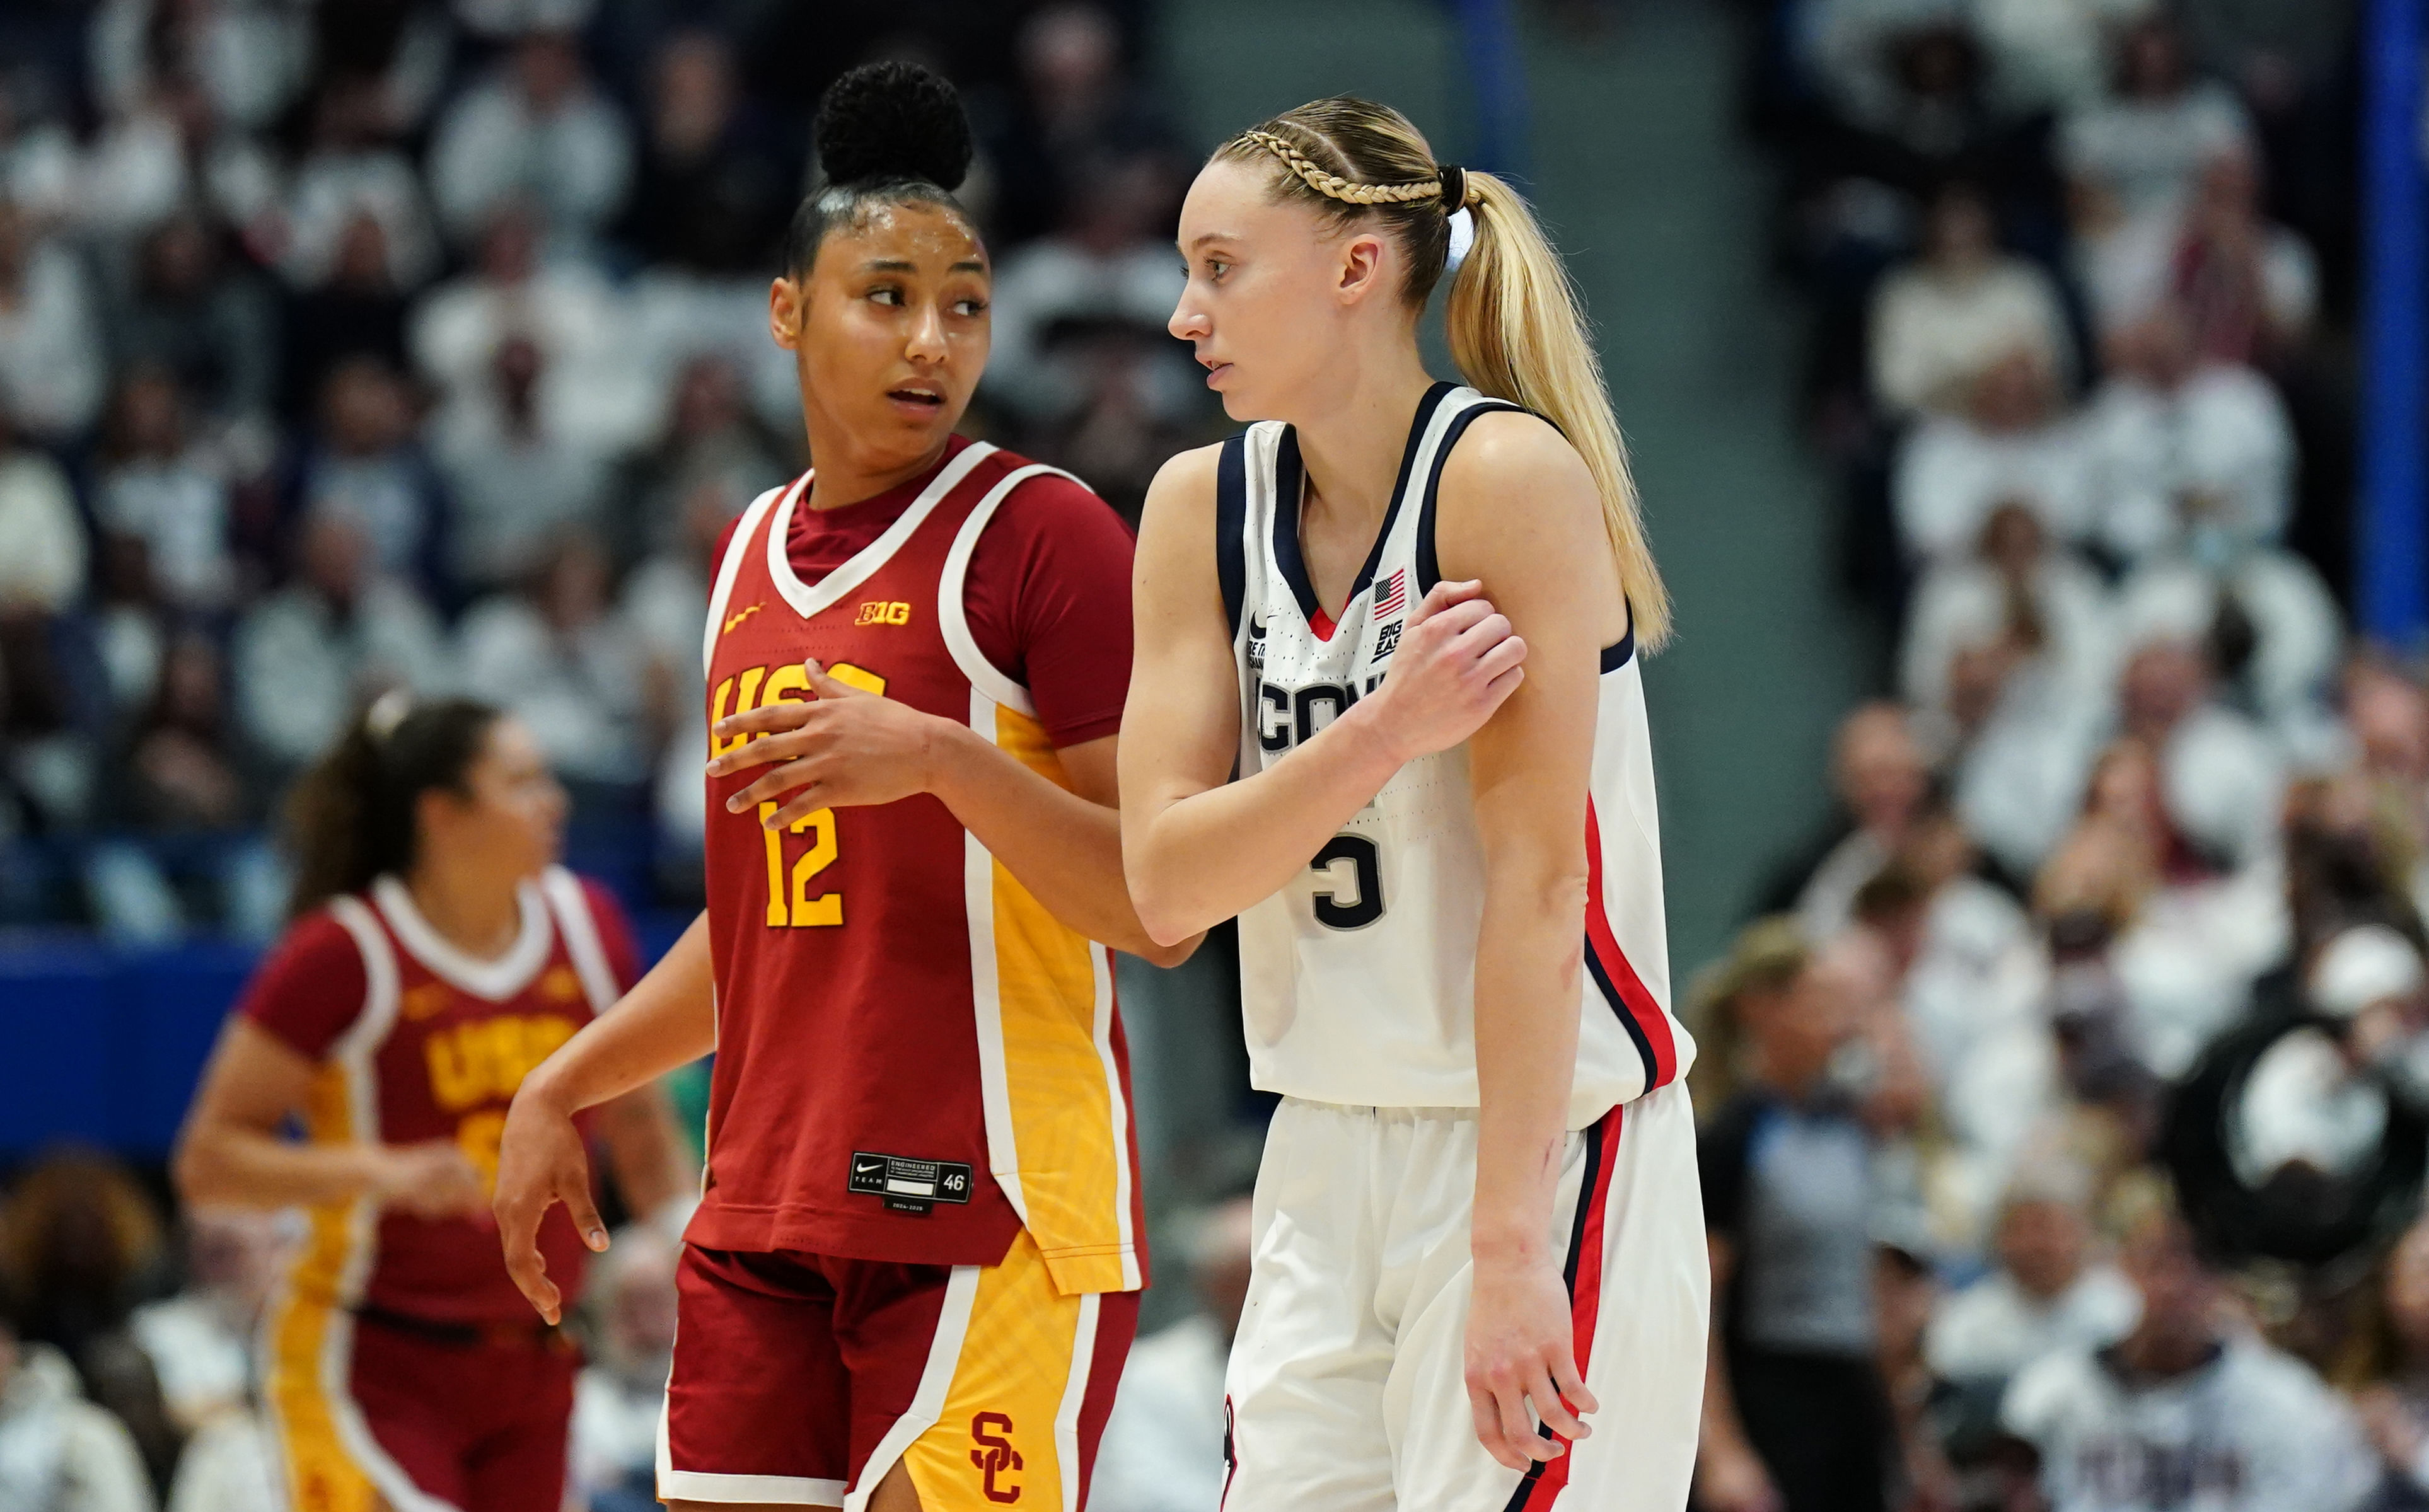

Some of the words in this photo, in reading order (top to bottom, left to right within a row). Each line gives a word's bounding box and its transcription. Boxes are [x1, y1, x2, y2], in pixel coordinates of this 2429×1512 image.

[1379, 619, 1403, 642] BIG
[1374, 634, 1401, 655] EAS
[758, 801, 843, 928] 12
[855, 1176, 883, 1185] TEAM
[943, 1174, 965, 1191] 46
[970, 1411, 1023, 1504] SC
